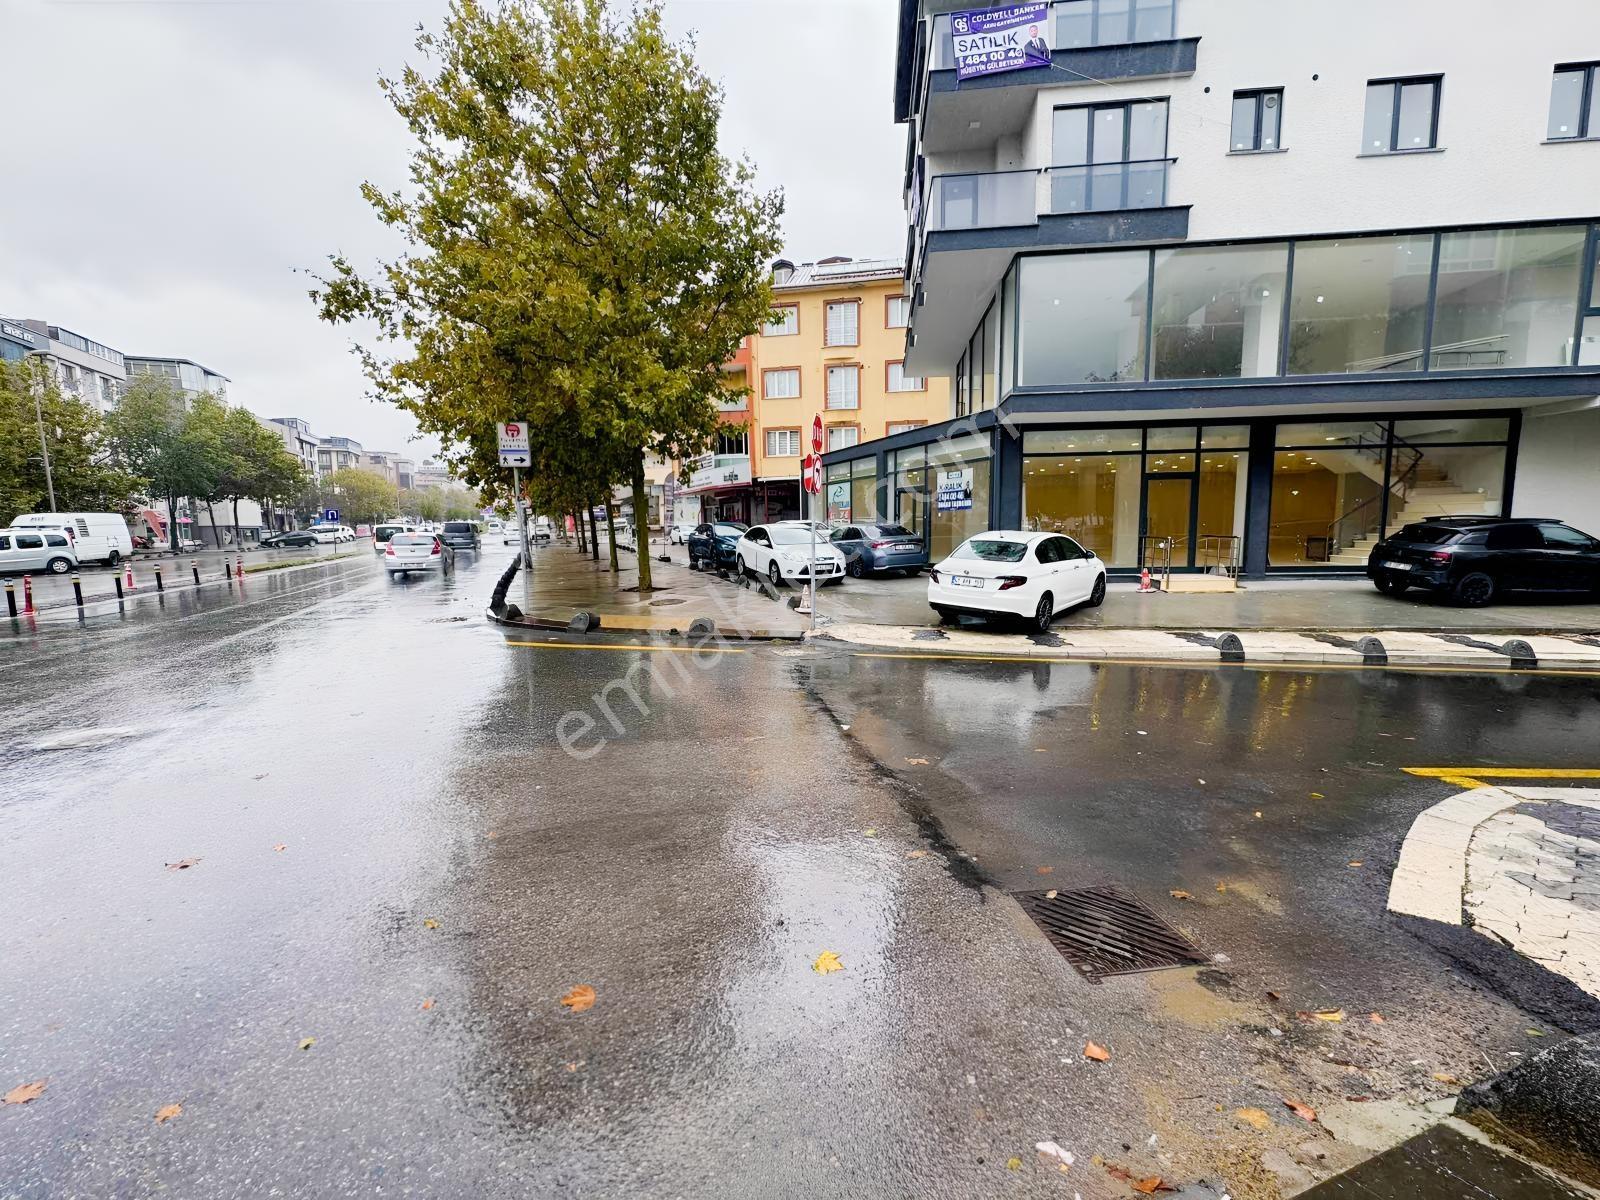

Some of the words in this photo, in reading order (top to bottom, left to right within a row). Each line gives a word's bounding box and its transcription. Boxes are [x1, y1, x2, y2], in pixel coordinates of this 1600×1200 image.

[972, 10, 1012, 22] COLDWELL
[1014, 3, 1045, 16] BANKER
[958, 32, 1018, 53] SATILIK
